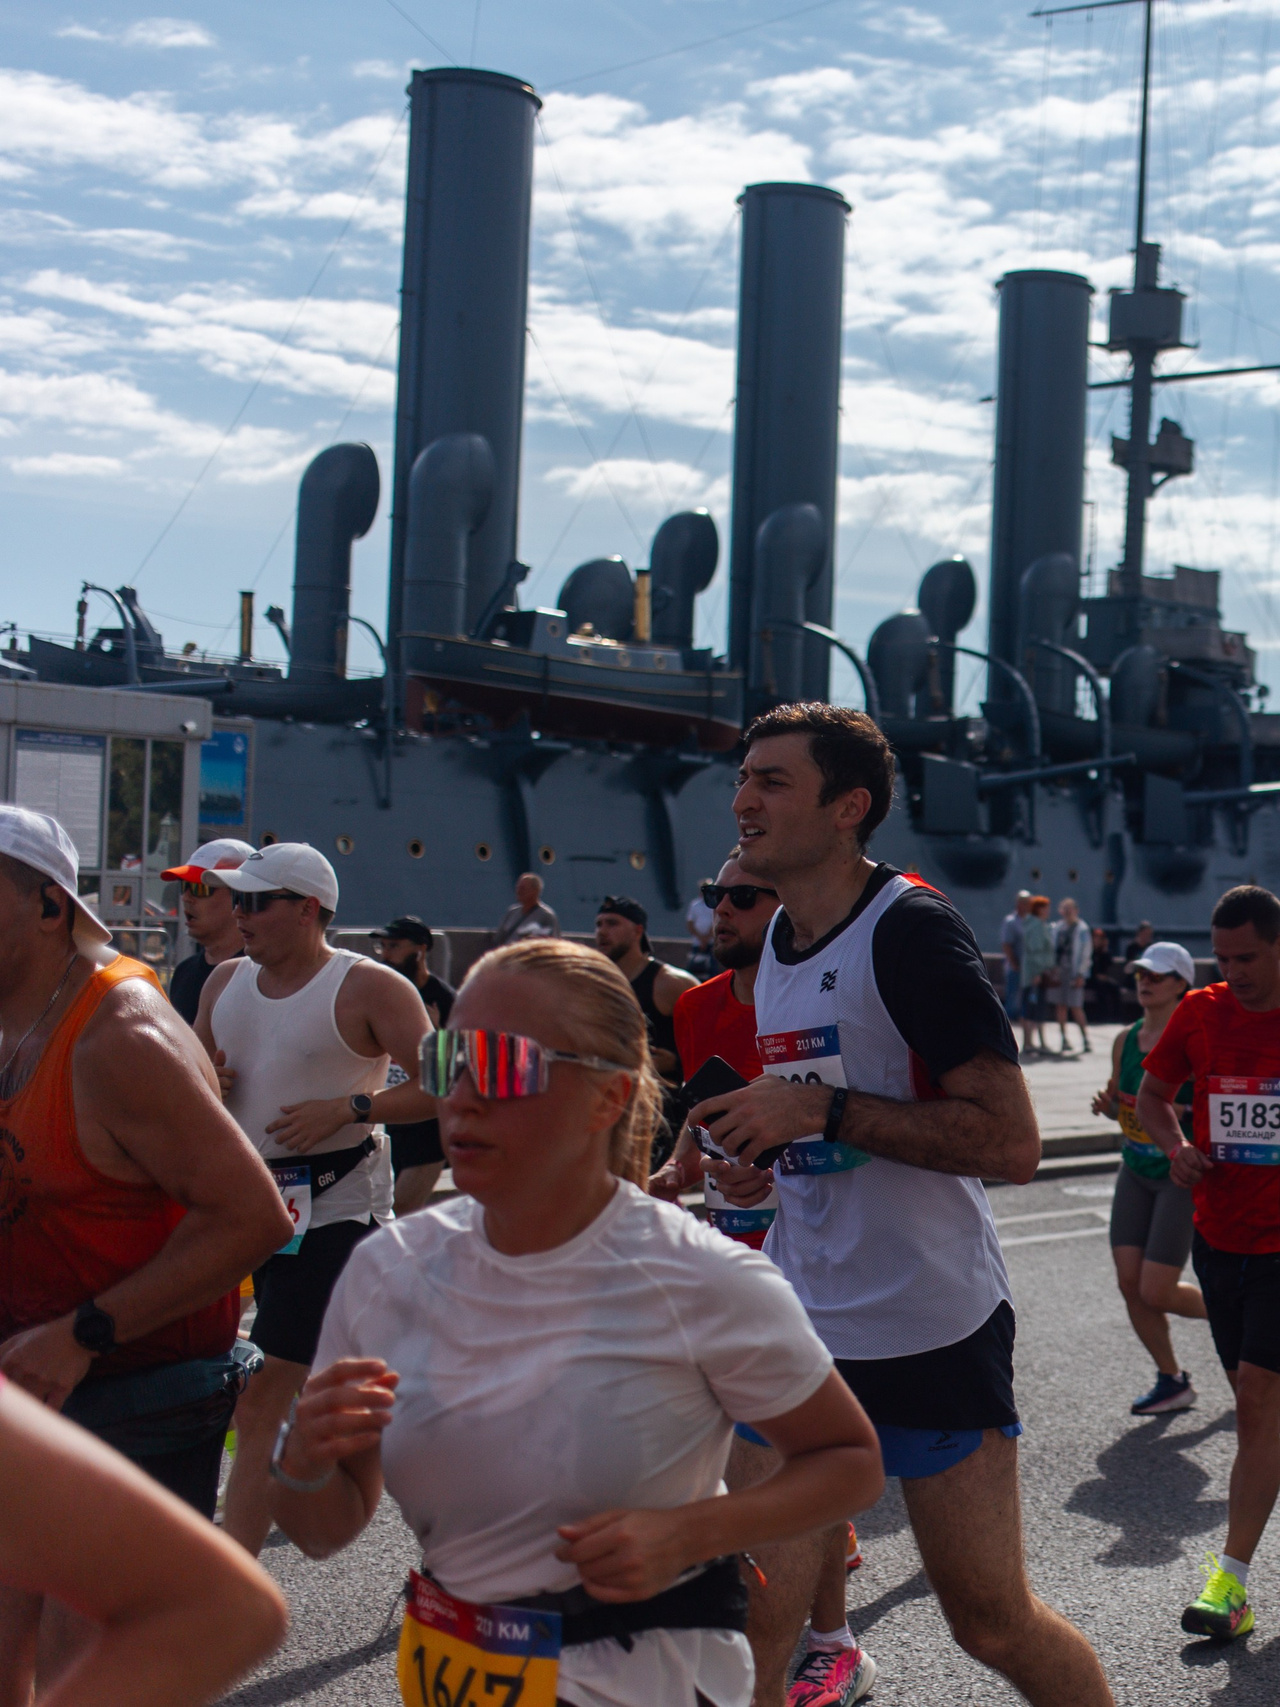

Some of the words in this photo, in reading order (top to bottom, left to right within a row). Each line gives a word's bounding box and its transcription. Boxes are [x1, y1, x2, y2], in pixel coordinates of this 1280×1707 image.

[796, 1038, 810, 1051] 21,1
[1259, 1082, 1272, 1091] 21,1
[1226, 1130, 1276, 1140] АЛЕКСАНДР
[318, 1170, 336, 1187] GRi
